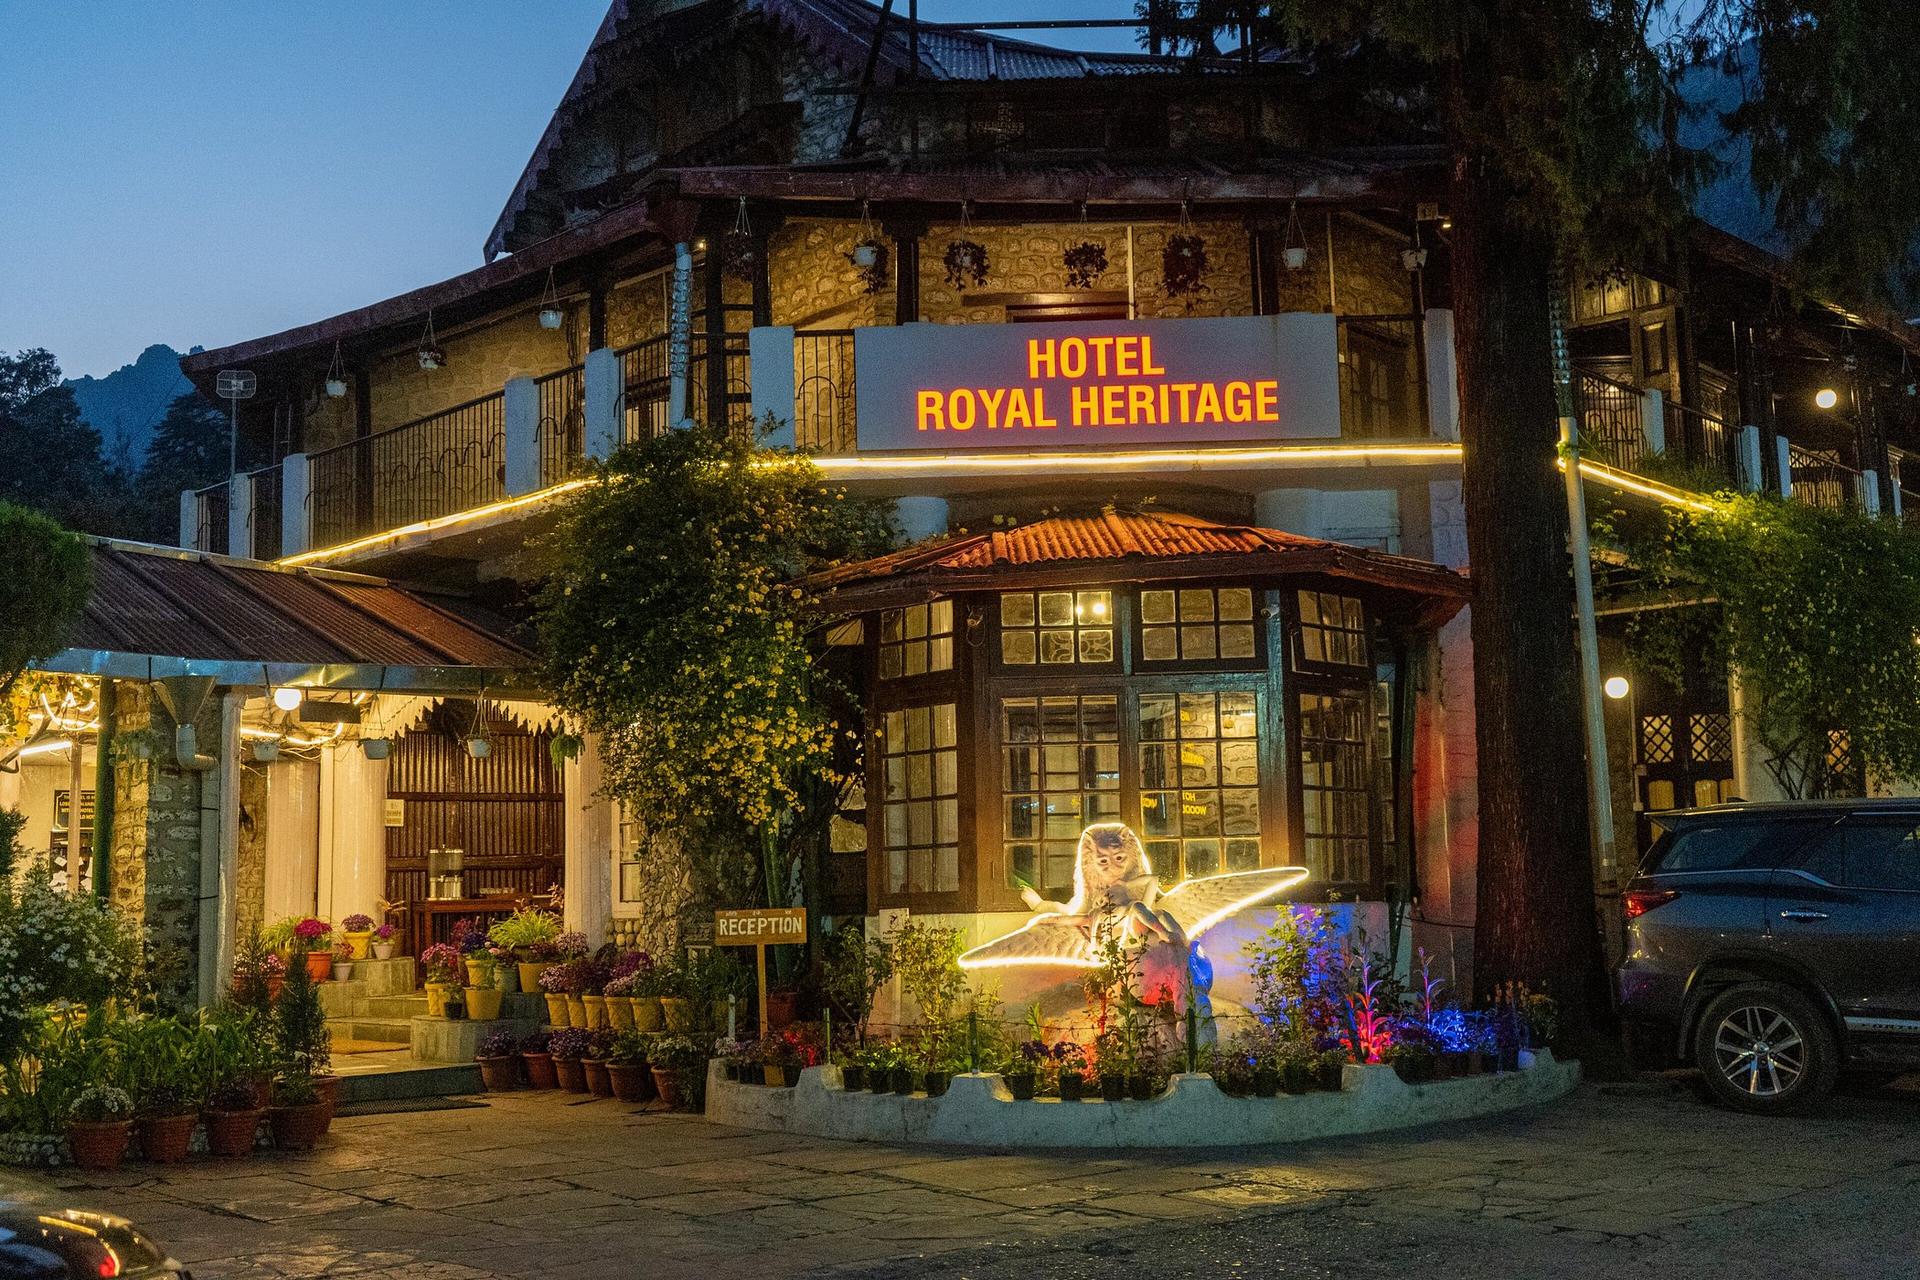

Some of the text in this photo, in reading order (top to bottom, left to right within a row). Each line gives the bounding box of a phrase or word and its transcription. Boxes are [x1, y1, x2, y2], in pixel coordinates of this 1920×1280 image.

[1027, 335, 1166, 379] HOTEL
[916, 380, 1279, 431] ROYAL HERITAGE
[719, 917, 802, 935] RECEPTION
